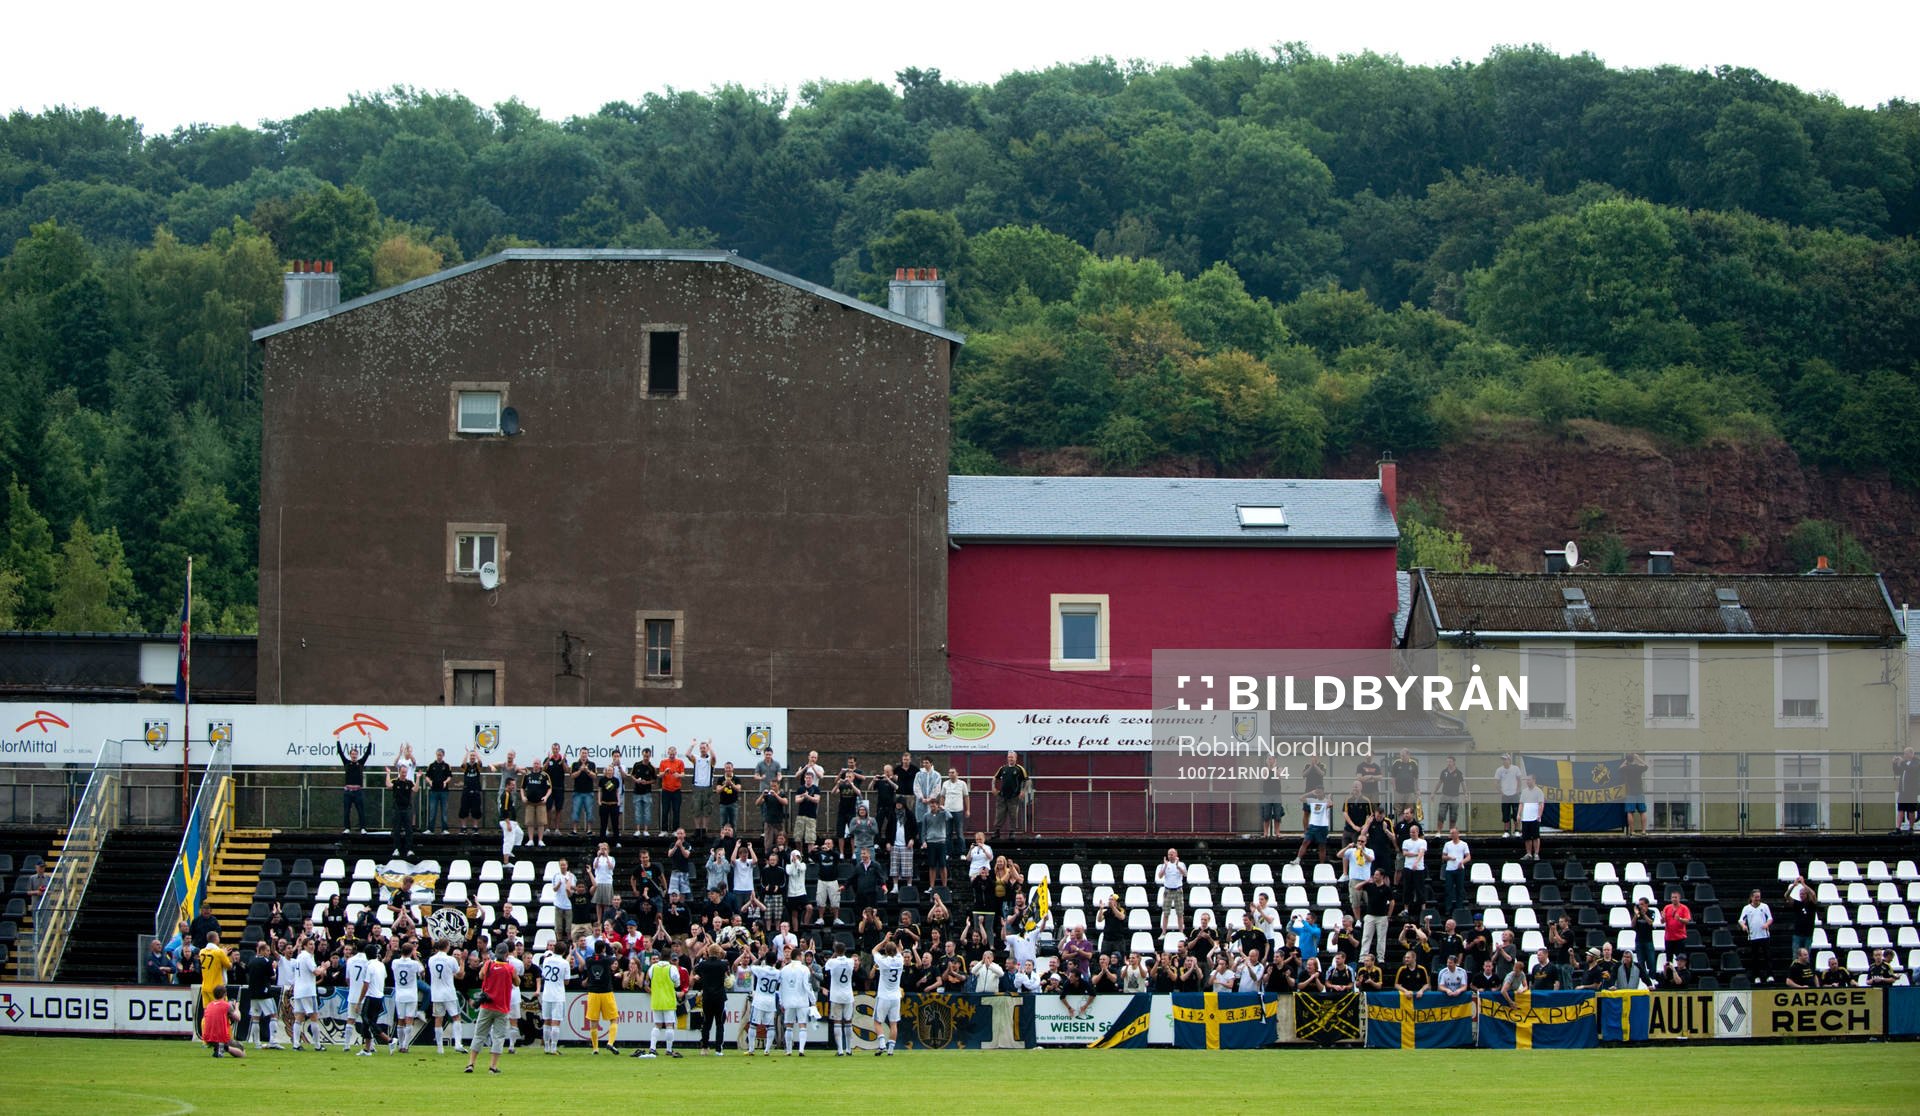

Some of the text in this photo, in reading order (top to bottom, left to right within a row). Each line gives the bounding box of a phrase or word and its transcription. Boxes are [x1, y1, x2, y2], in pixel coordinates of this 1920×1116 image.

[1018, 713, 1052, 725] Mei
[1057, 713, 1110, 725] stoark
[0, 739, 57, 753] lorMittal
[1032, 735, 1072, 746] Plus
[1078, 735, 1110, 749] fort
[565, 744, 655, 758] ArelorMittl
[354, 965, 363, 981] 7
[399, 970, 408, 986] 8
[435, 963, 444, 980] 9
[544, 965, 560, 983] 28
[839, 968, 849, 984] 6
[888, 968, 899, 983] 3
[760, 977, 778, 994] 30
[1774, 991, 1866, 1007] GARAGE
[30, 997, 108, 1020] LOGIS
[1480, 1000, 1595, 1024] HAGA PUB
[1649, 996, 1713, 1034] AULT
[1035, 1013, 1073, 1021] Plantations
[1772, 1009, 1870, 1032] RECH
[1051, 1022, 1095, 1033] WEISEN
